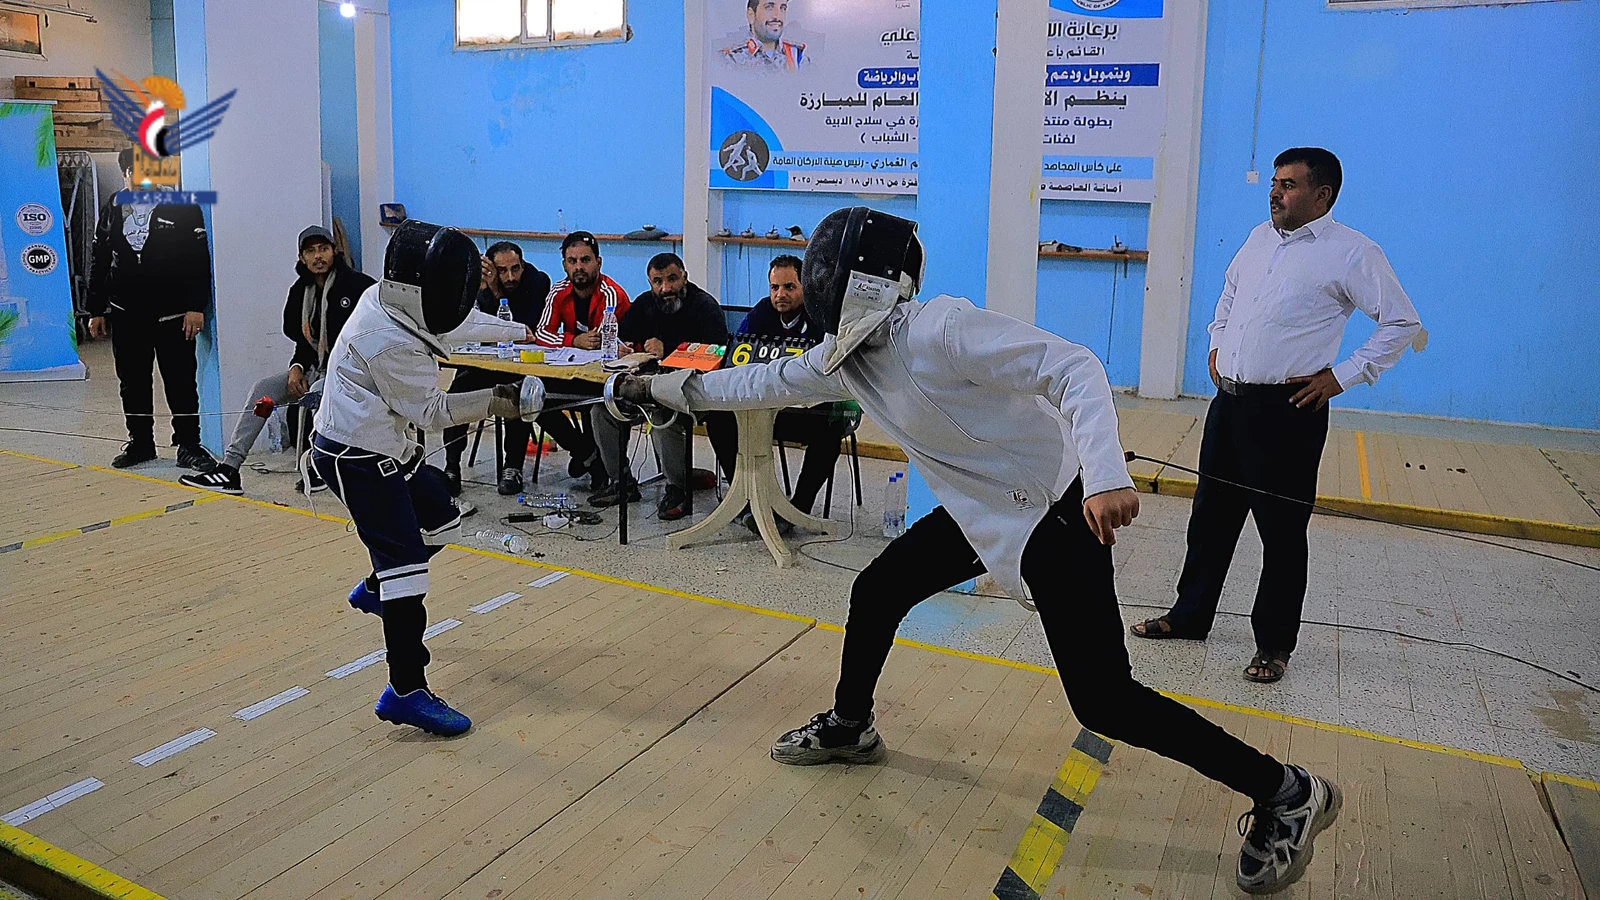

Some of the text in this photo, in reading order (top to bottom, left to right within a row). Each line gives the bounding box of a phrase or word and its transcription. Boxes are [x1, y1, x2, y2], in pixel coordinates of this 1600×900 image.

[881, 28, 916, 46] علي
[1067, 22, 1118, 40] برعاية
[1066, 45, 1105, 59] القائم
[1050, 67, 1131, 83] وبتمويل ودعم
[800, 92, 918, 111] العام للمبارزة
[1064, 90, 1127, 111] ينظم
[825, 116, 852, 128] الابية
[855, 116, 882, 128] سلاح
[885, 116, 906, 130] في
[1073, 116, 1112, 129] بطولة
[871, 131, 909, 144] الشباب
[773, 156, 796, 166] العامة
[844, 157, 865, 169] رئيس
[871, 157, 907, 169] الغماري
[1044, 160, 1122, 174] على كأس المجاهد
[792, 176, 811, 184] ٢٠٢٥
[815, 176, 843, 187] ديسمبر
[850, 177, 860, 185] ١٨
[875, 178, 885, 186] ١٦
[887, 179, 898, 188] من
[1049, 181, 1091, 192] العاصمة
[23, 213, 46, 221] ISO
[28, 255, 50, 264] GMP
[732, 343, 753, 366] 6
